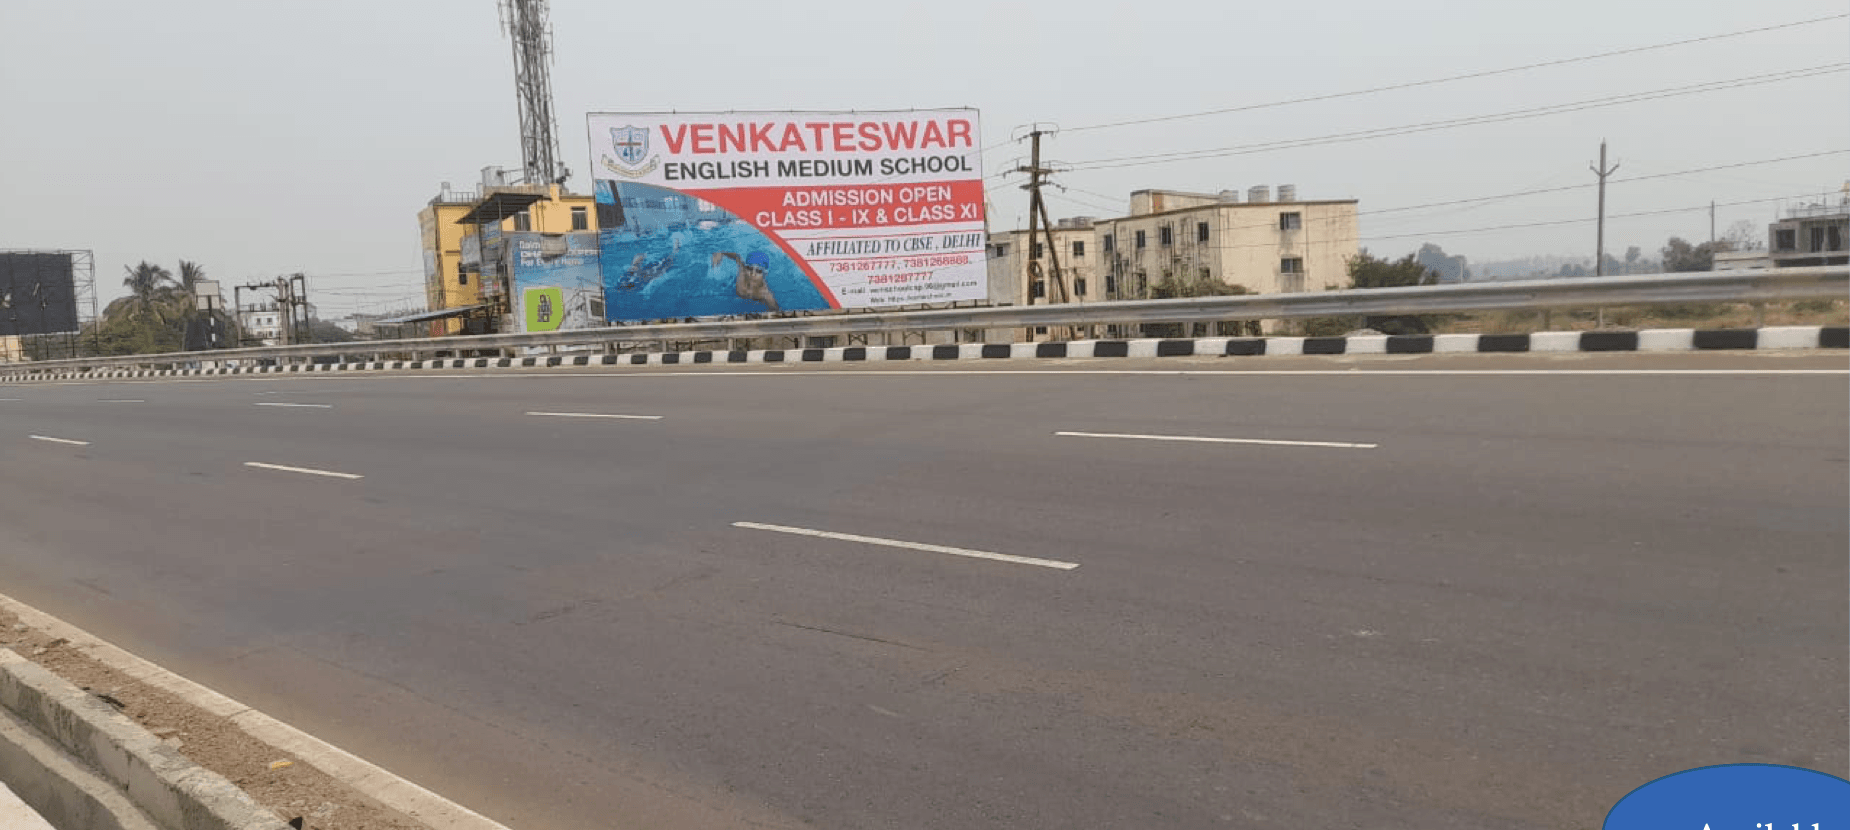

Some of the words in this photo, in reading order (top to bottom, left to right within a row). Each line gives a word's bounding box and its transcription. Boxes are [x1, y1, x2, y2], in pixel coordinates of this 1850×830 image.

[659, 119, 972, 155] VENKATESWAR
[664, 160, 770, 180] ENGLISH
[777, 159, 873, 177] MEDIUM
[880, 155, 972, 175] SCHOOL
[782, 188, 893, 206] ADMISSION
[899, 185, 952, 202] OPEN
[756, 210, 822, 228] CLASS
[852, 208, 870, 224] IX
[875, 208, 888, 223] &
[893, 204, 955, 223] CLASS
[960, 203, 977, 219] XI
[807, 240, 881, 256] AFFILIATED
[884, 239, 900, 251] TO
[942, 233, 981, 249] DELHI
